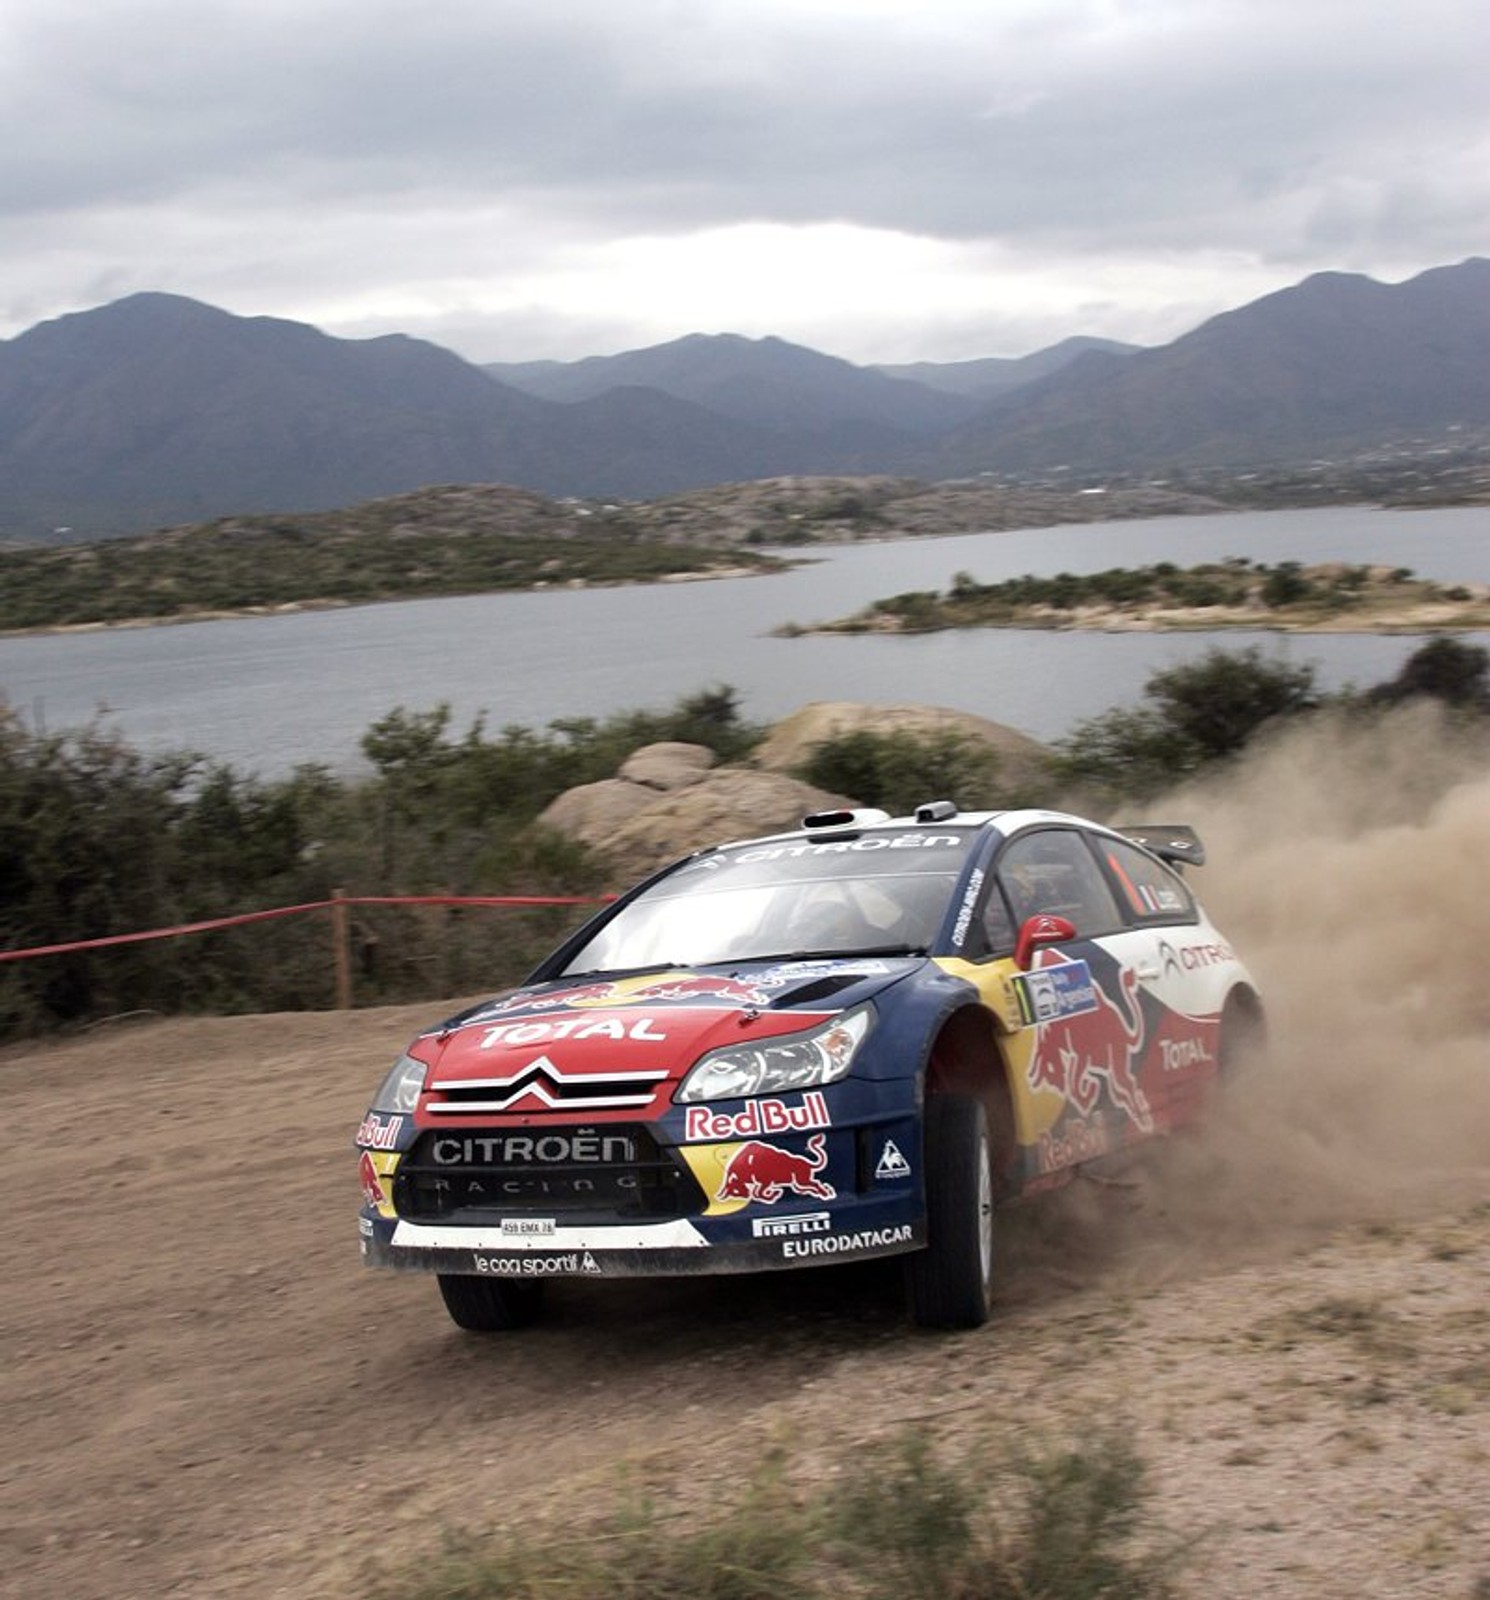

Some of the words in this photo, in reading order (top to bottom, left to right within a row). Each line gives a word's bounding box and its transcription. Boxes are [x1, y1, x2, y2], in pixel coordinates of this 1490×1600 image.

[479, 1018, 667, 1049] TOTAL
[1158, 1036, 1213, 1071] TOTAL
[685, 1100, 760, 1140] Red
[758, 1092, 832, 1133] Bull
[752, 1212, 831, 1237] PIRELLI
[782, 1225, 913, 1258] EURODATACAR
[522, 1253, 577, 1276] sportif
